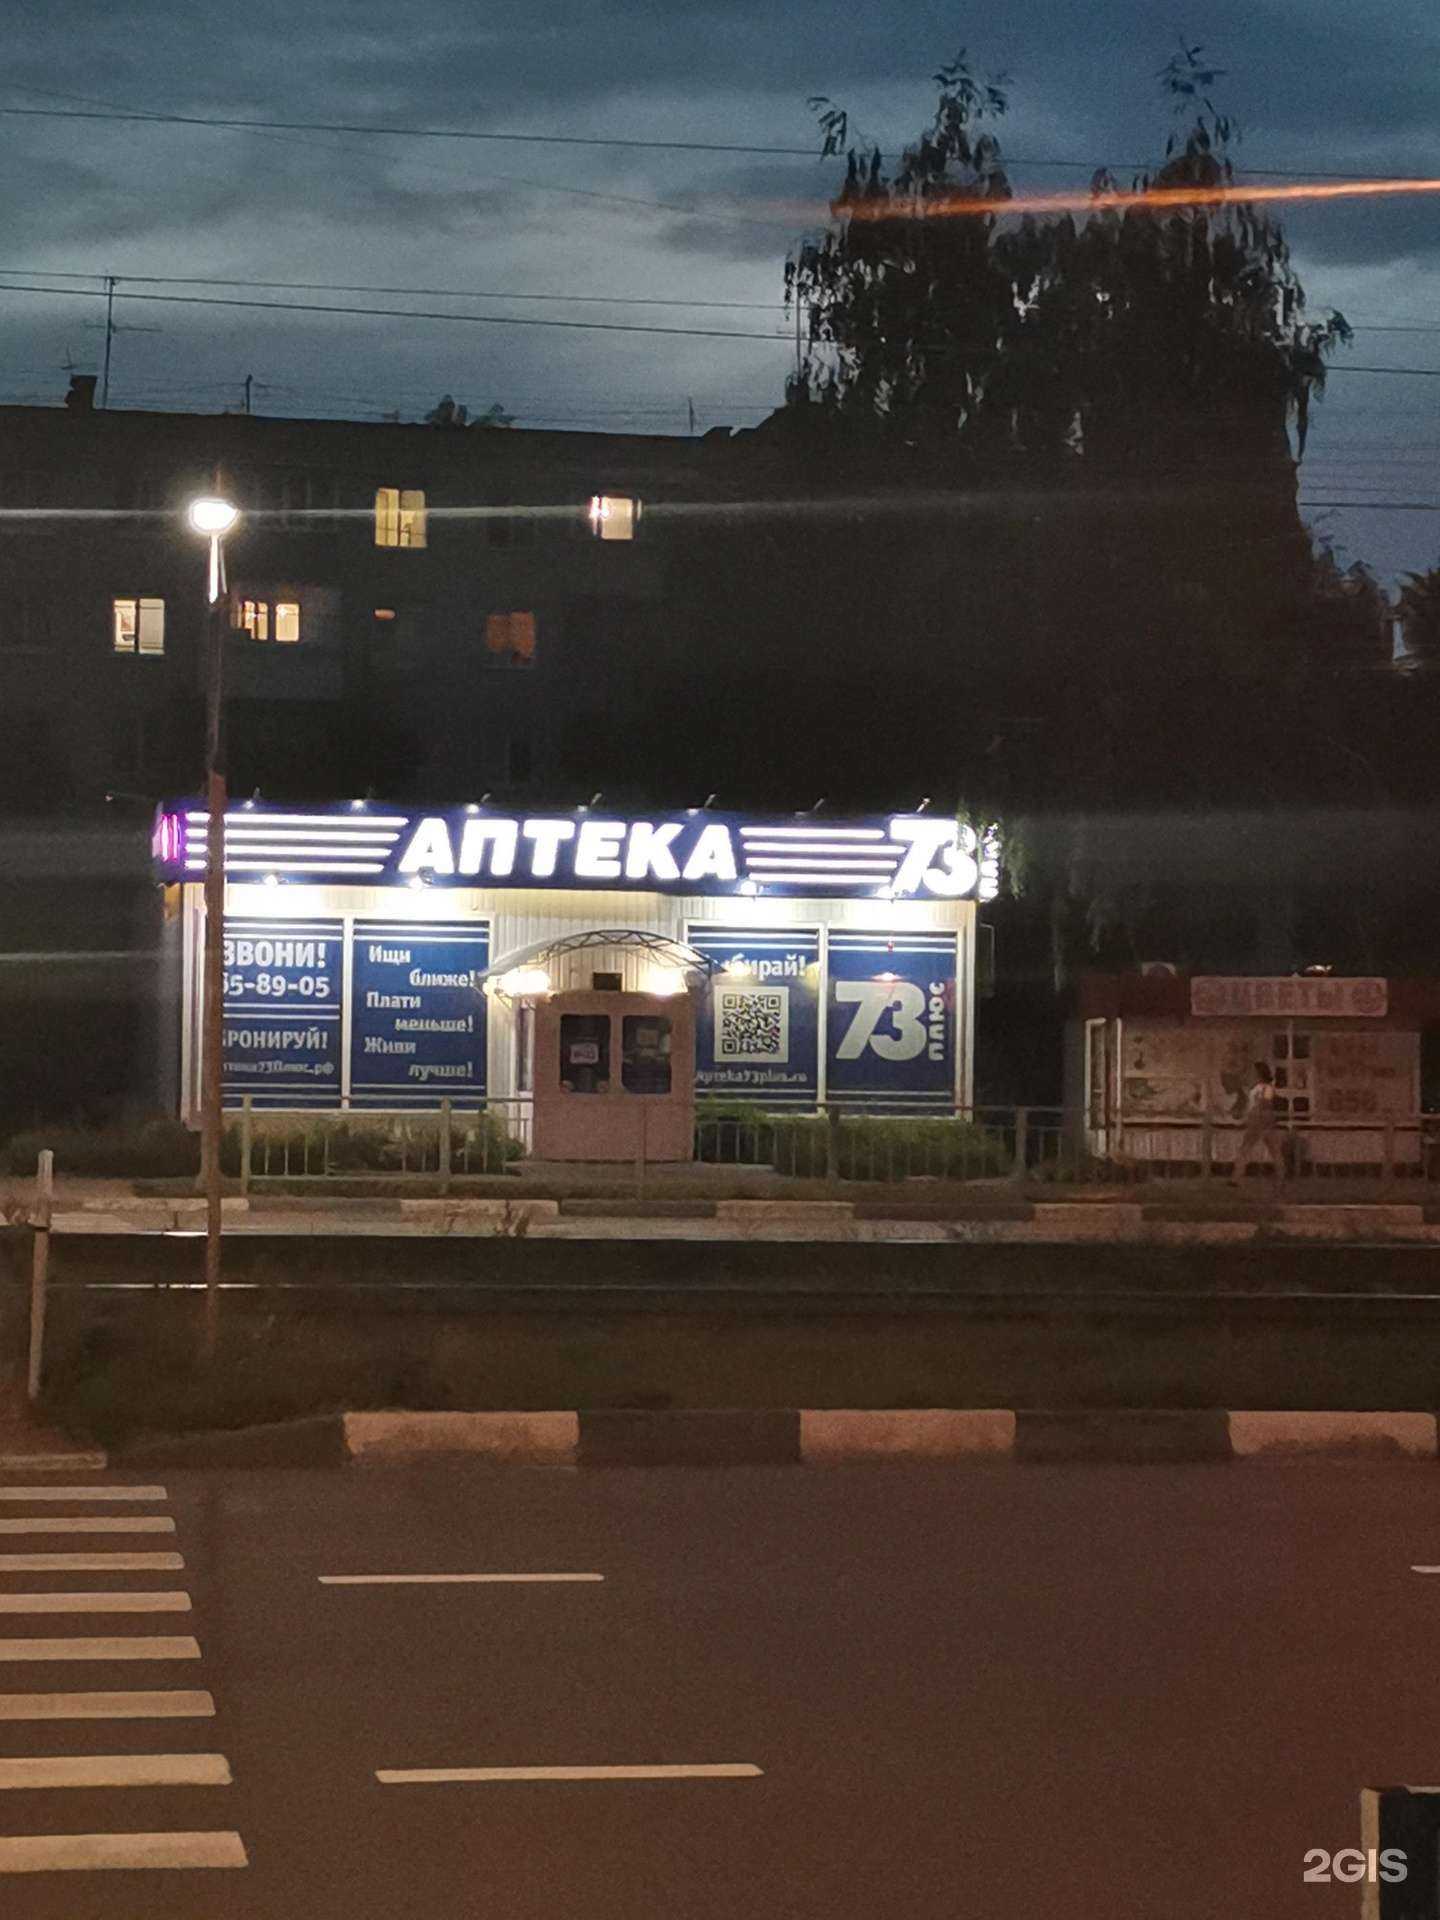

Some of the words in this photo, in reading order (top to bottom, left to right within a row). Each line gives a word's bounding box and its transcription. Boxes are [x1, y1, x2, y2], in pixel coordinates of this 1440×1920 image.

[398, 818, 737, 879] АПТЕКА
[889, 818, 978, 896] 73
[223, 940, 326, 968] ЗВОНИ!
[368, 945, 411, 966] Ищи
[409, 968, 475, 987] ближе!
[366, 991, 421, 1008] Плати
[395, 1015, 474, 1033] меньше!
[836, 980, 927, 1060] 73
[222, 1026, 328, 1049] РОНИРУЙ!
[364, 1036, 416, 1055] Живи
[408, 1061, 473, 1081] лучше!
